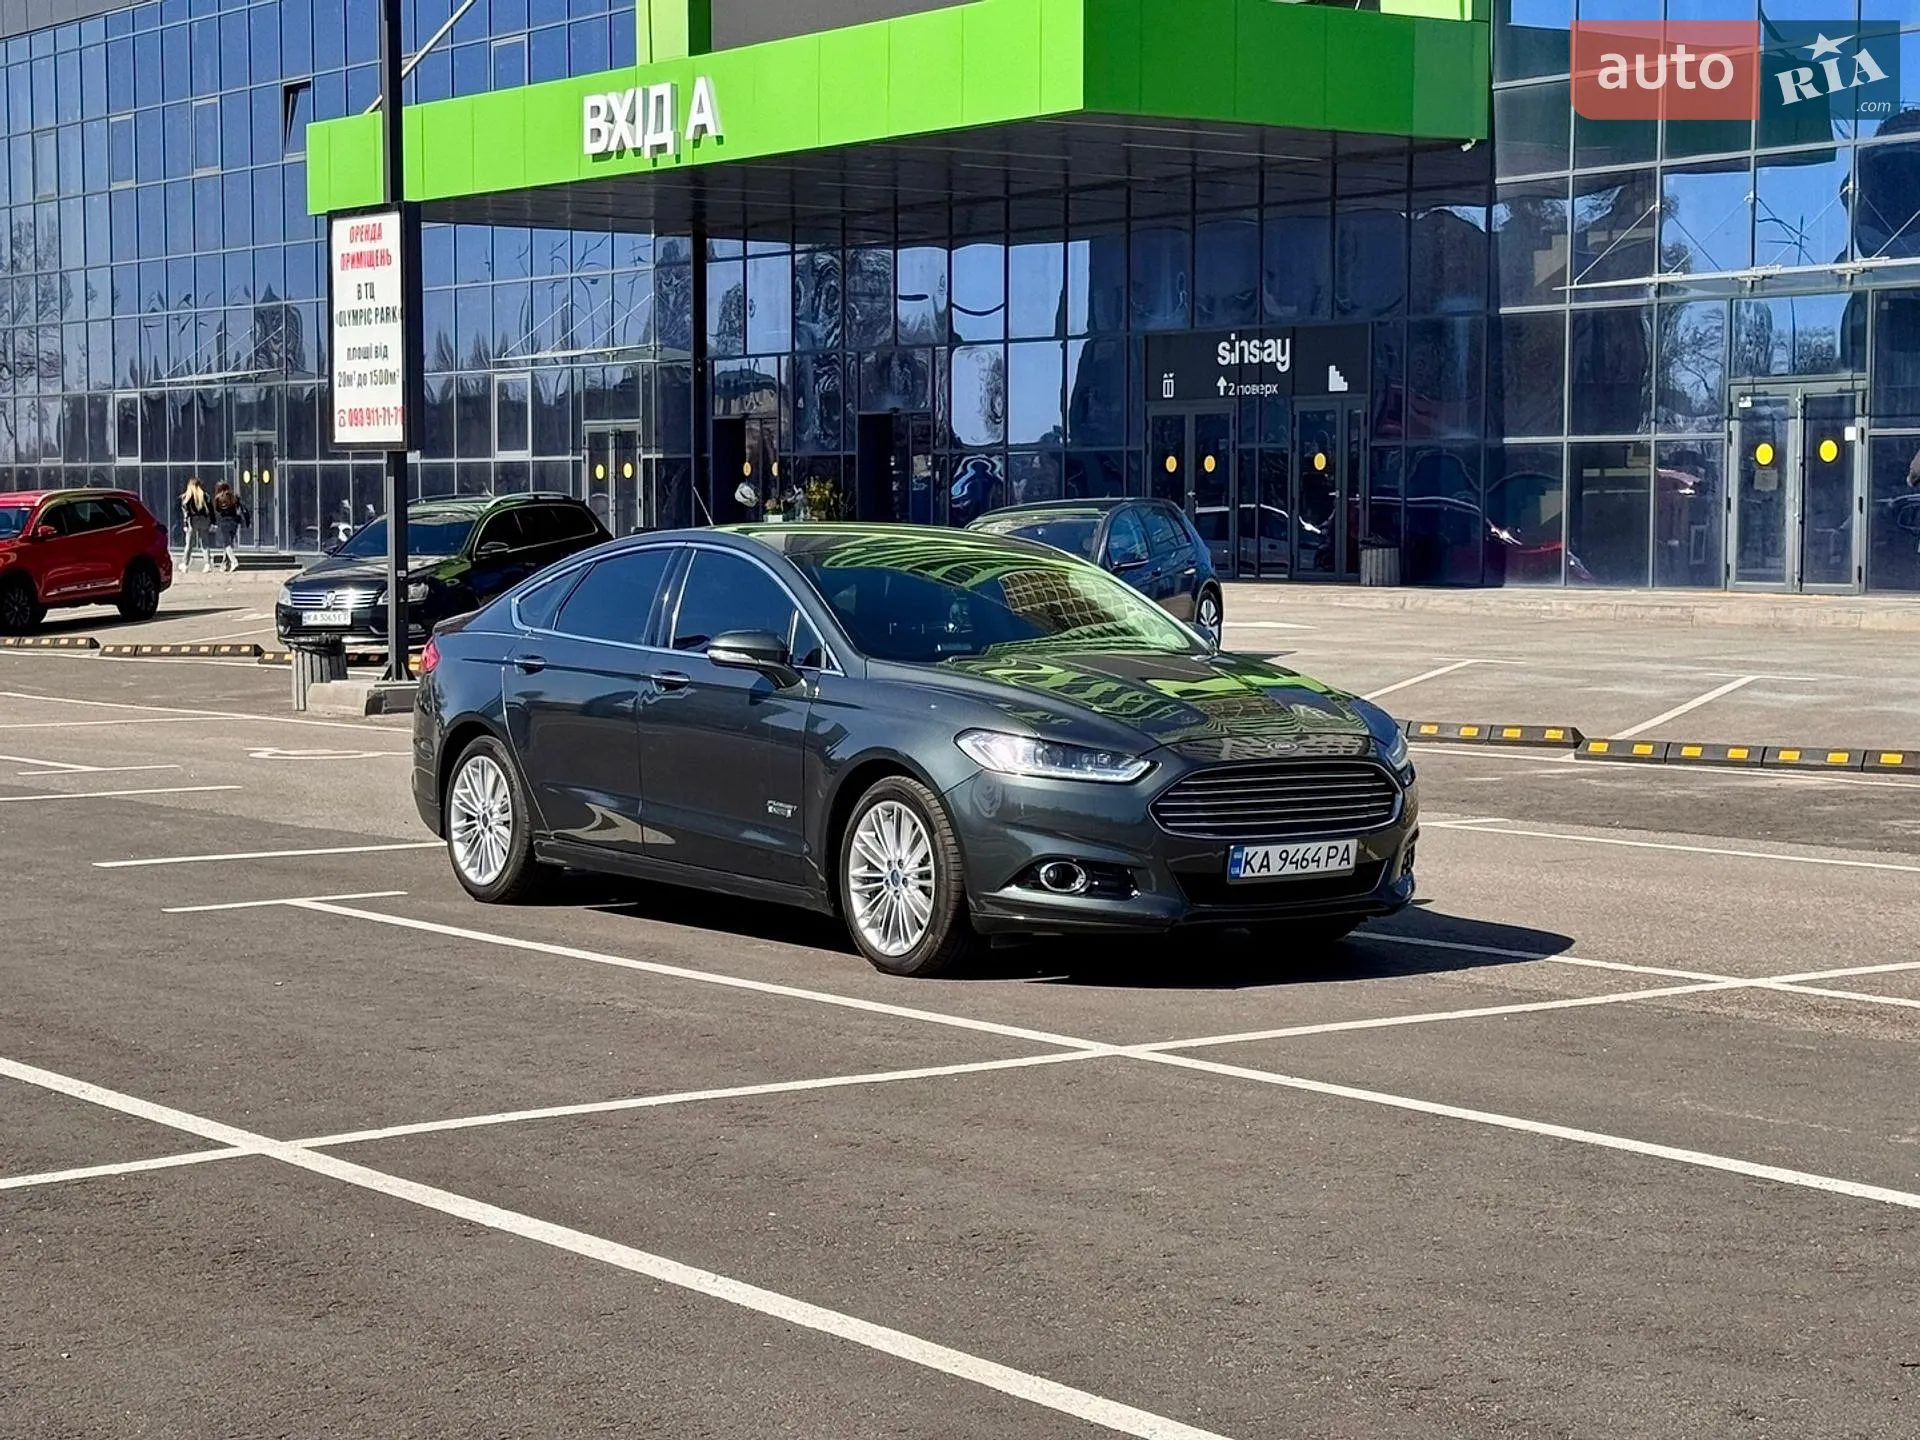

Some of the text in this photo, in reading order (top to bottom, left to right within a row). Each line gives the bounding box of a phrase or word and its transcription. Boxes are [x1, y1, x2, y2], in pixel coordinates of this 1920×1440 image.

[583, 82, 680, 159] ВХІД
[349, 222, 383, 244] ОРЕНДА
[340, 248, 392, 271] ПРИМІЩЕНЬ
[364, 282, 376, 302] ТЦ
[1217, 333, 1291, 372] sinsay
[1227, 382, 1279, 398] 2 поверх
[348, 407, 365, 427] 093
[1242, 843, 1351, 874] KA 9464 PA
